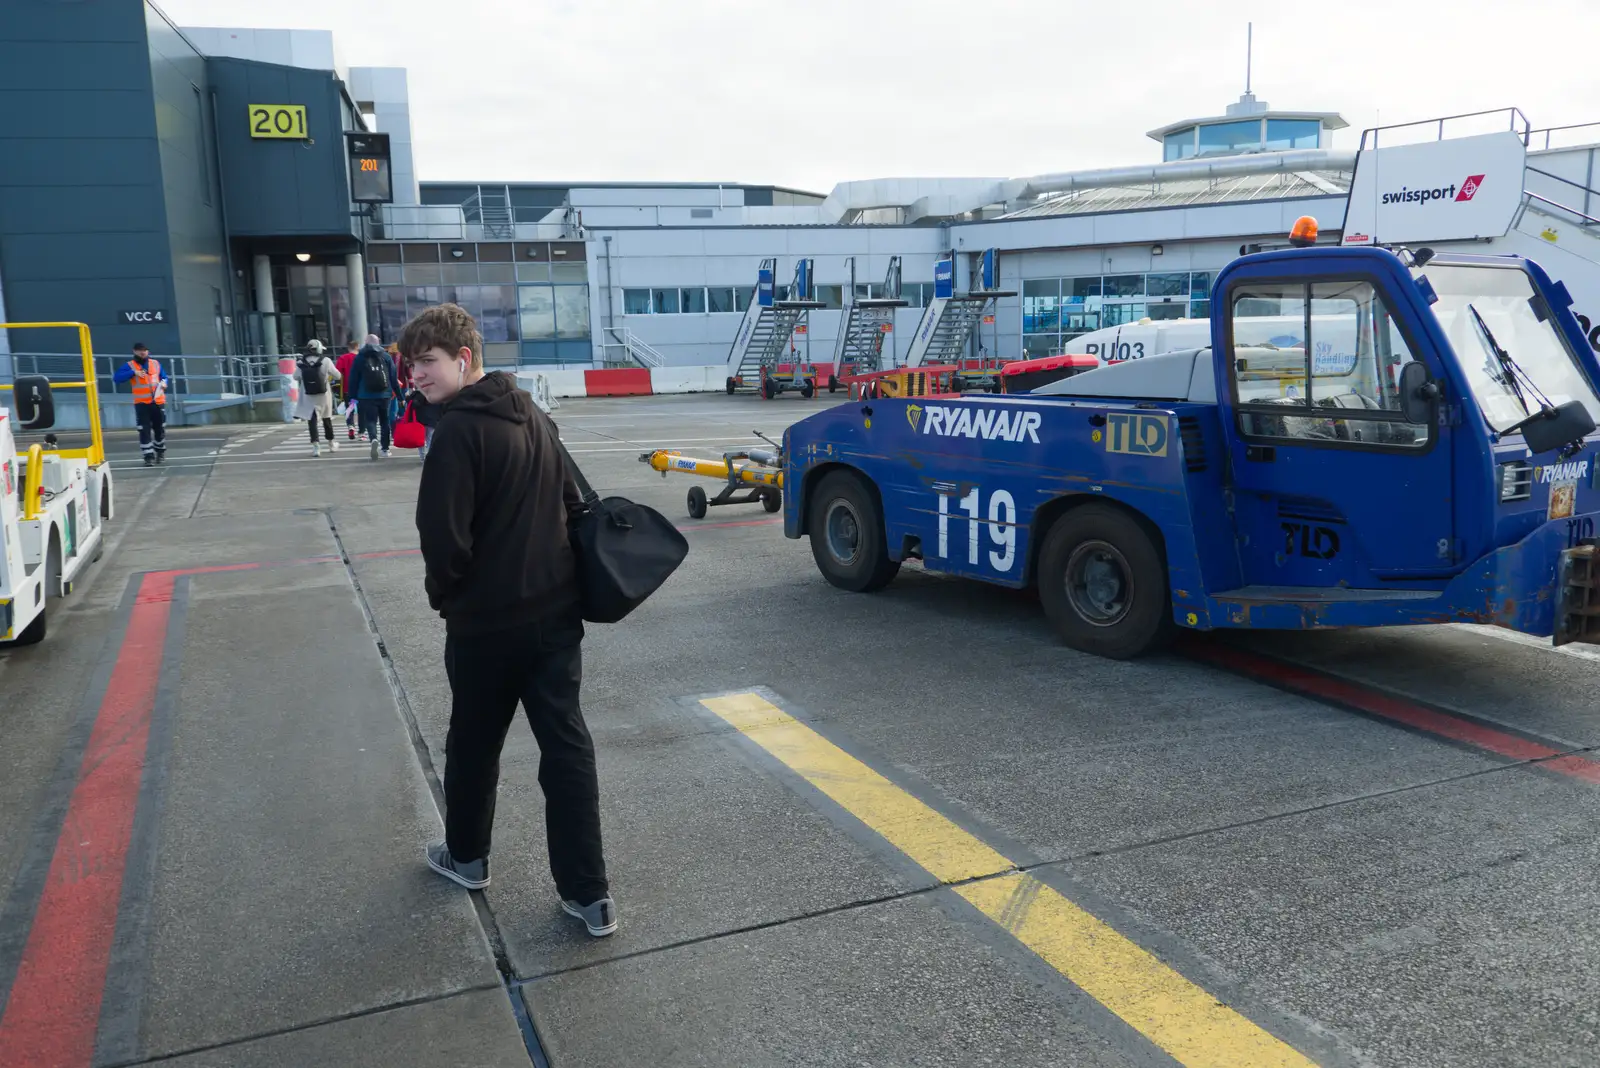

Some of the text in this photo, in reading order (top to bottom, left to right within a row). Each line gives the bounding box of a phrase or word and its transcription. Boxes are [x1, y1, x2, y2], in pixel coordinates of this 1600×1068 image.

[253, 109, 304, 134] 201
[360, 159, 378, 171] 201
[1382, 184, 1456, 205] swissport
[125, 311, 163, 321] VCC 4
[1316, 341, 1333, 355] Sky
[1316, 352, 1357, 366] Handling
[923, 405, 1042, 444] RYANAIR
[1108, 414, 1167, 454] TLD
[1541, 460, 1588, 484] RYANAIR
[938, 487, 1016, 572] 119
[1281, 521, 1340, 560] TLD
